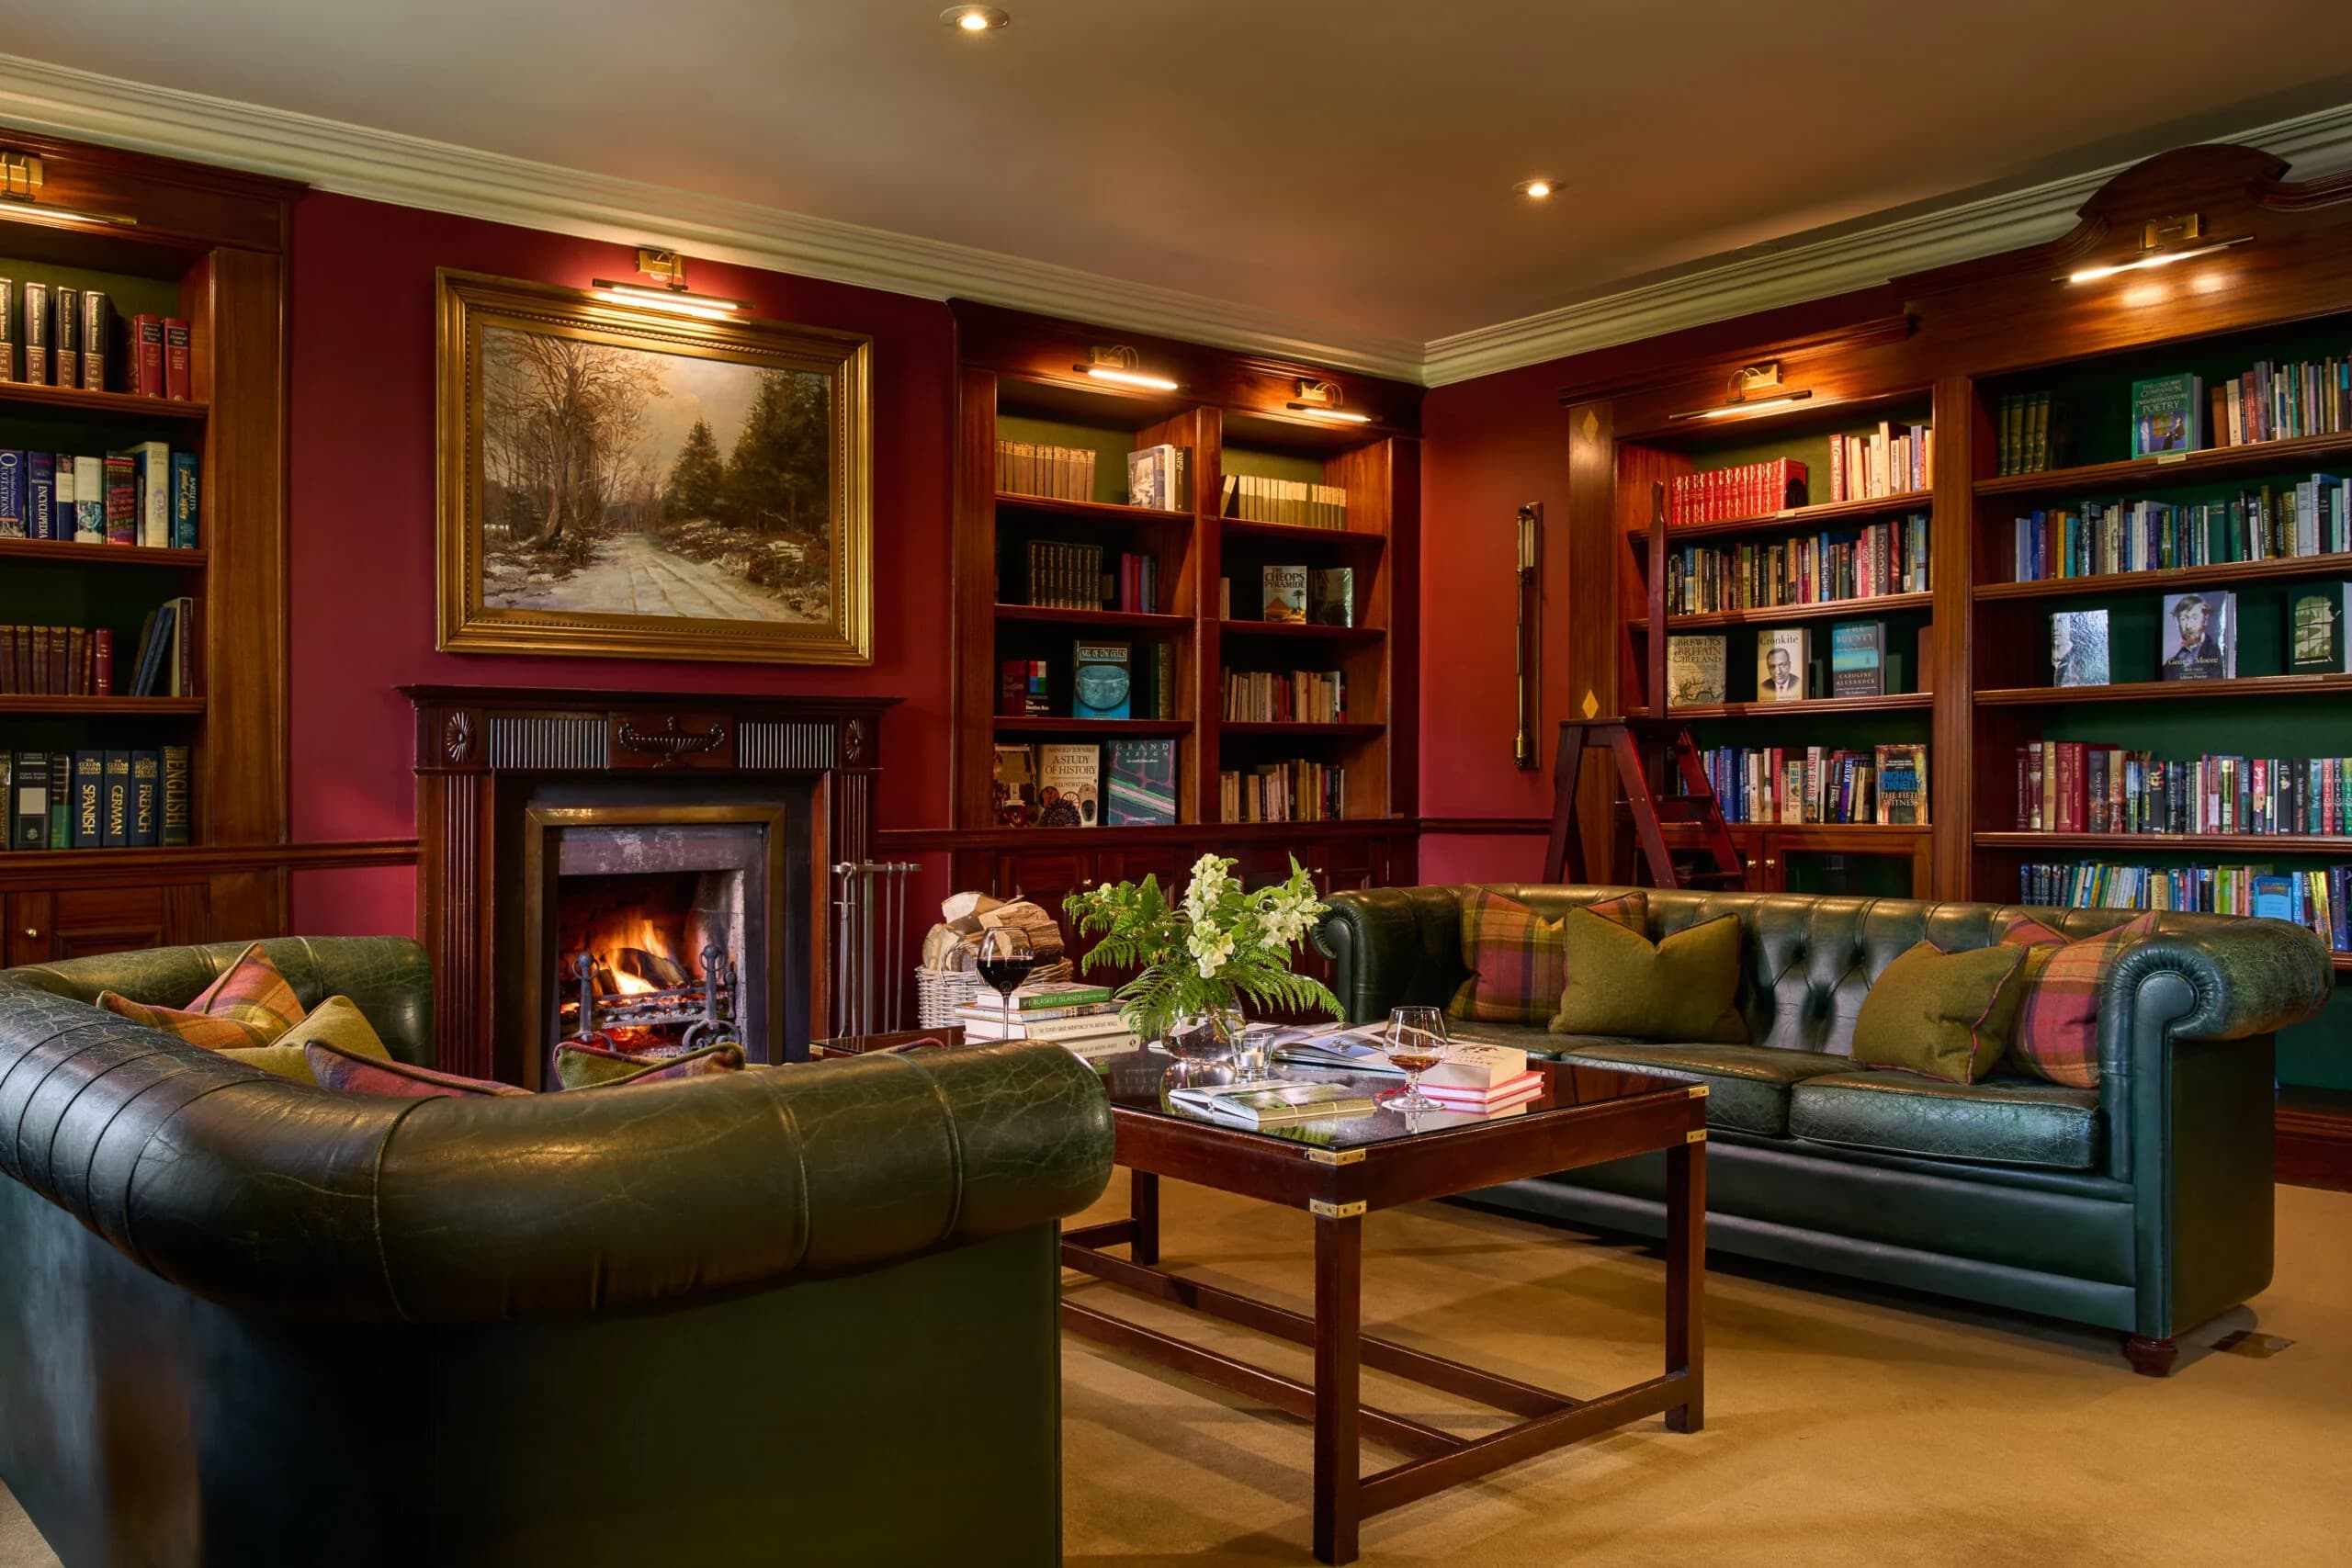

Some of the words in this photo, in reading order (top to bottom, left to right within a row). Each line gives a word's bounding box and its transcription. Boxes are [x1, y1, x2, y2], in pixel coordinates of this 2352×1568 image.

[2143, 401, 2179, 413] POETRY
[38, 486, 49, 538] ENCYCLOPEDIA
[1265, 573, 1305, 581] CHEOPS
[1760, 635, 1798, 645] Cronkite
[1061, 755, 1089, 764] STUDY
[1808, 753, 1817, 771] TONY
[1045, 765, 1058, 774] OF
[1059, 765, 1096, 774] HISTORY
[1844, 764, 1853, 782] SILVA
[1881, 771, 1918, 780] MICHAEL
[166, 760, 187, 824] ENGLISH
[1808, 775, 1816, 797] BLAIR
[1879, 780, 1923, 790] CONNELLY
[83, 784, 96, 835] SPANISH
[111, 785, 123, 835] GERMAN
[138, 784, 153, 834] FRENCH
[1033, 997, 1057, 1005] BLASKET
[1058, 994, 1082, 1003] ISLANDS
